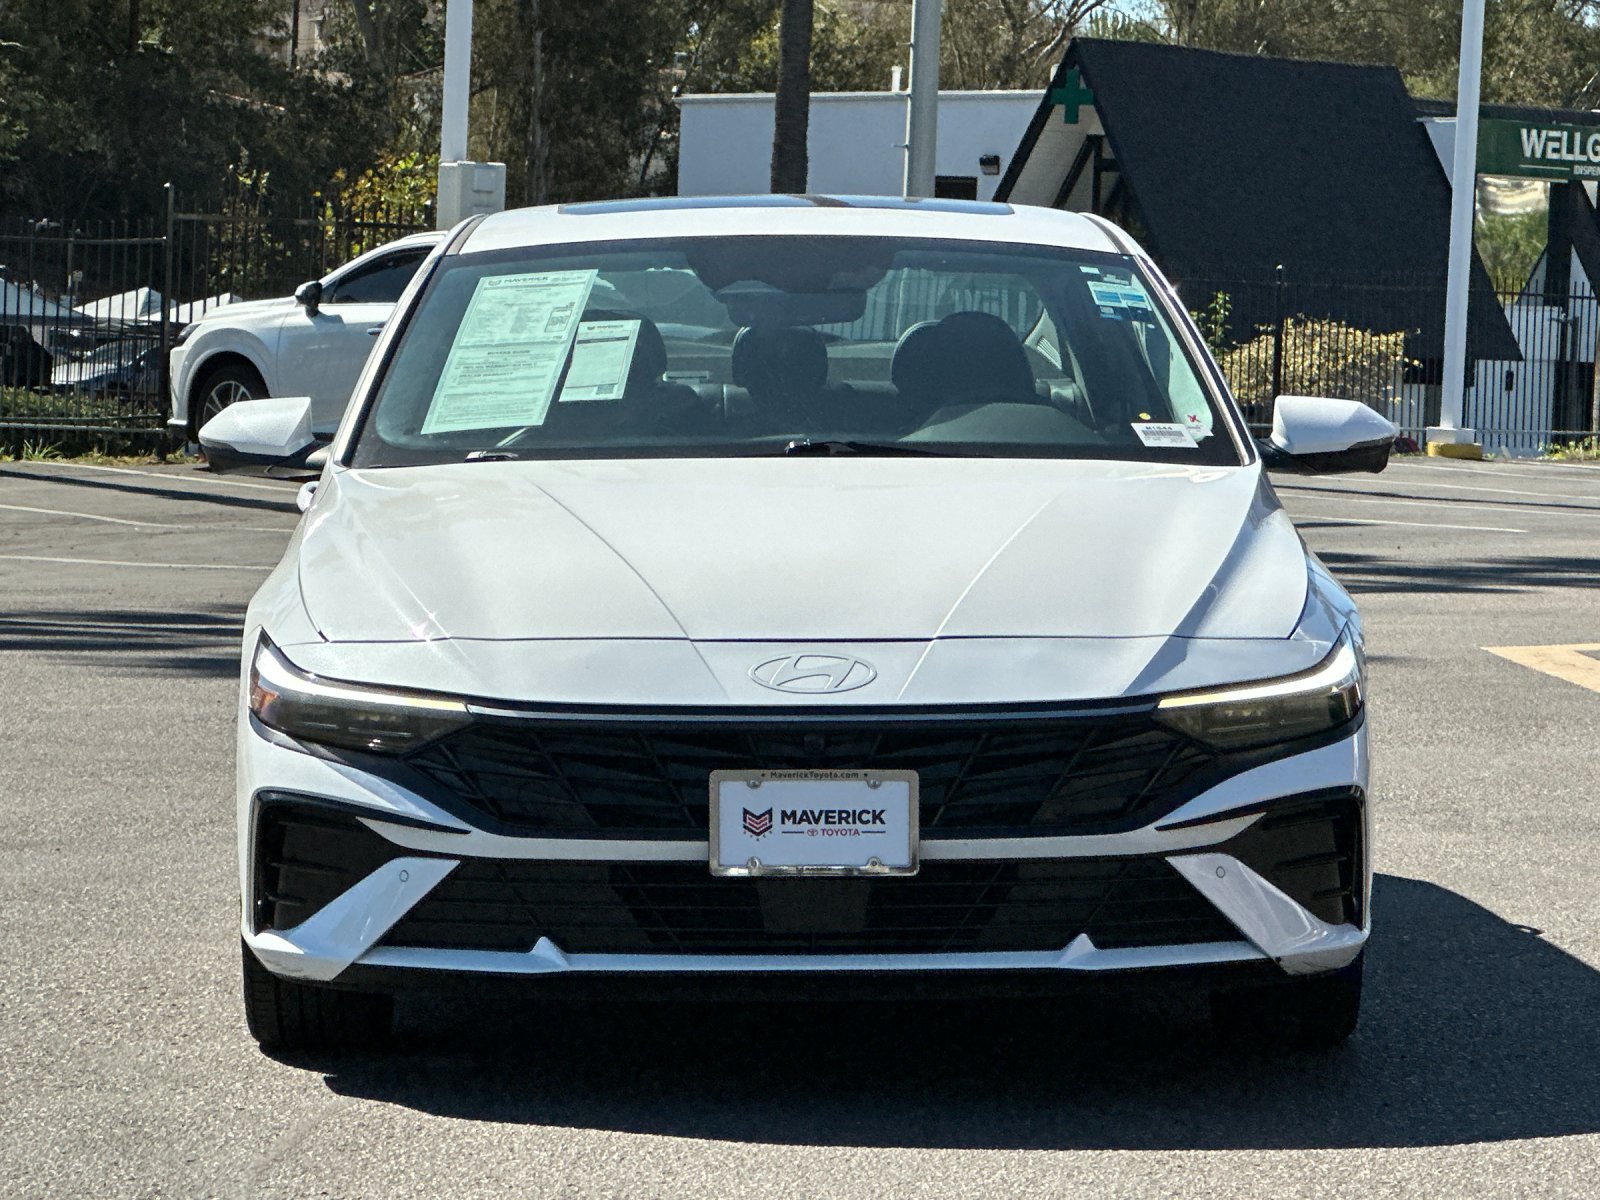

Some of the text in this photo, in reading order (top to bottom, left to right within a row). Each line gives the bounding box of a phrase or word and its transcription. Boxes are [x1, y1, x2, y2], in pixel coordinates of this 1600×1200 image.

[770, 771, 859, 779] MaverickToyota.com
[781, 809, 886, 825] MAVERICK
[821, 828, 860, 837] TOYOTA
